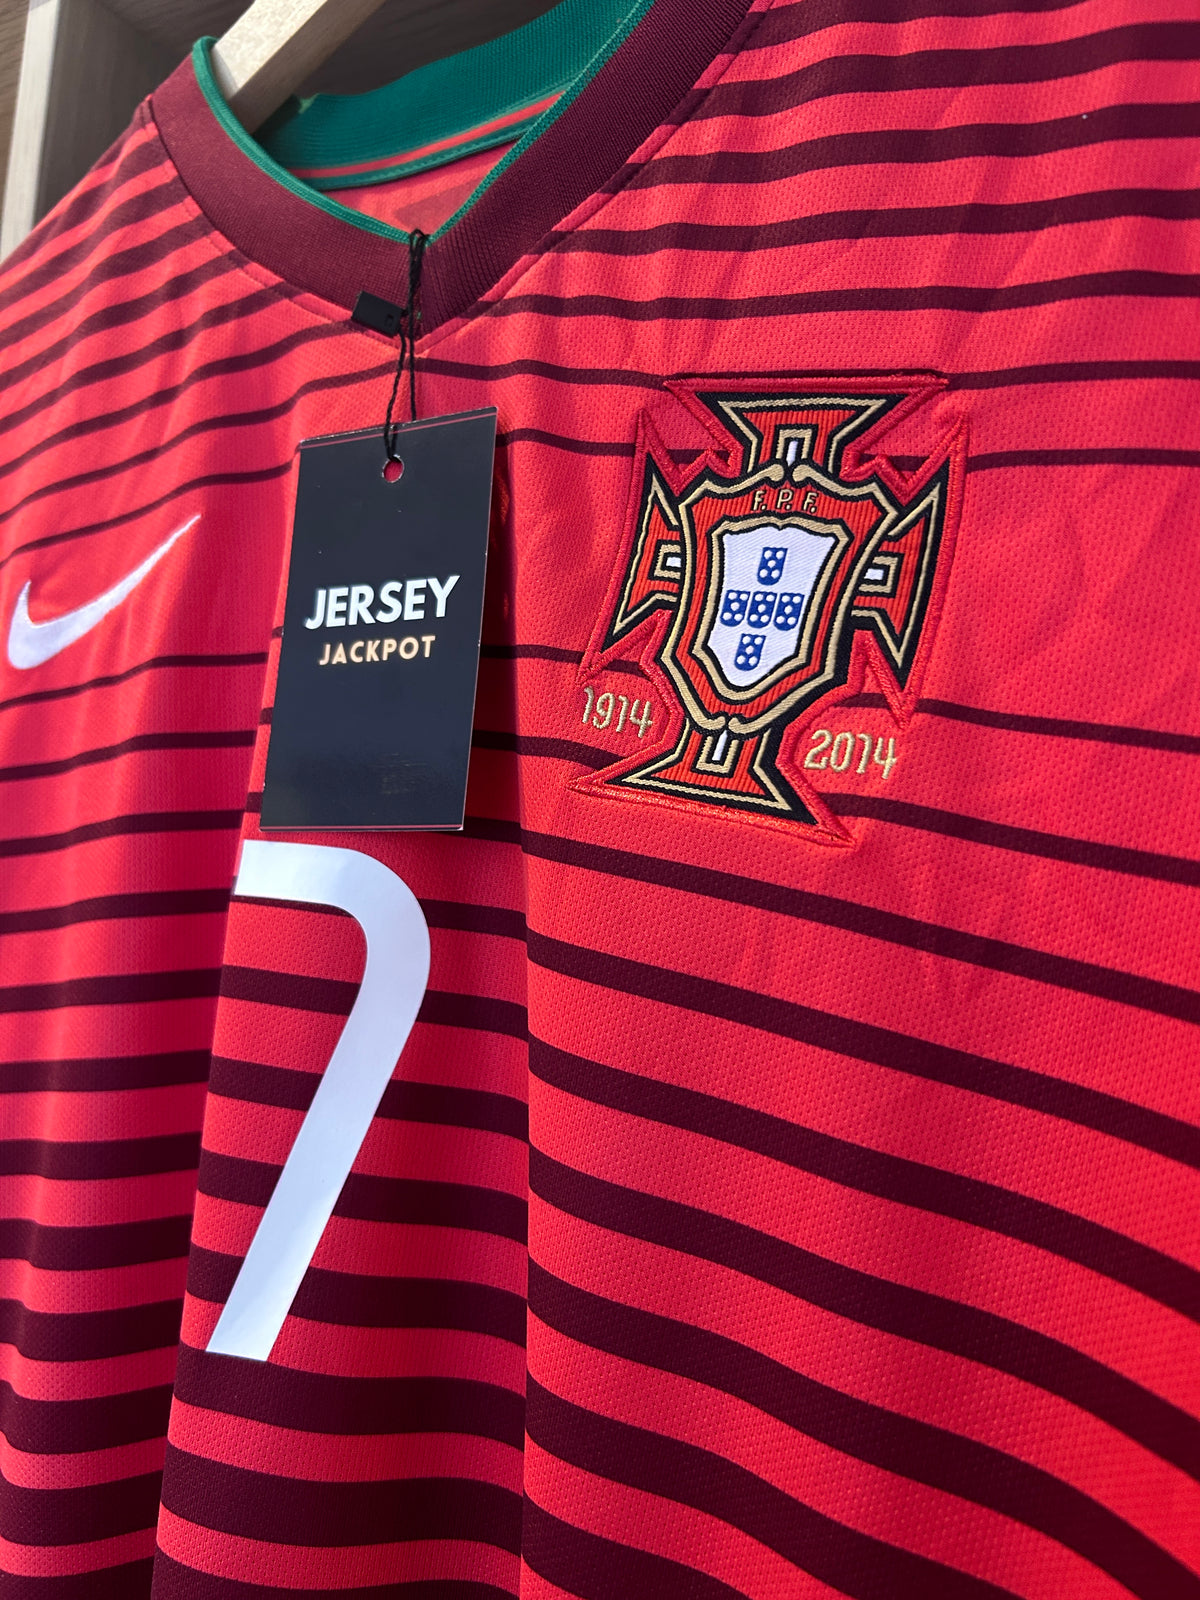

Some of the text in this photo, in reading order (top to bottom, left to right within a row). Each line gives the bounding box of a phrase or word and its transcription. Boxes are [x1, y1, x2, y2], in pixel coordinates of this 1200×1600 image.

[305, 576, 460, 629] JERSEY
[318, 635, 436, 666] JACKPOT
[581, 686, 653, 738] 1914
[803, 729, 897, 780] 2014
[205, 839, 431, 1362] 7
